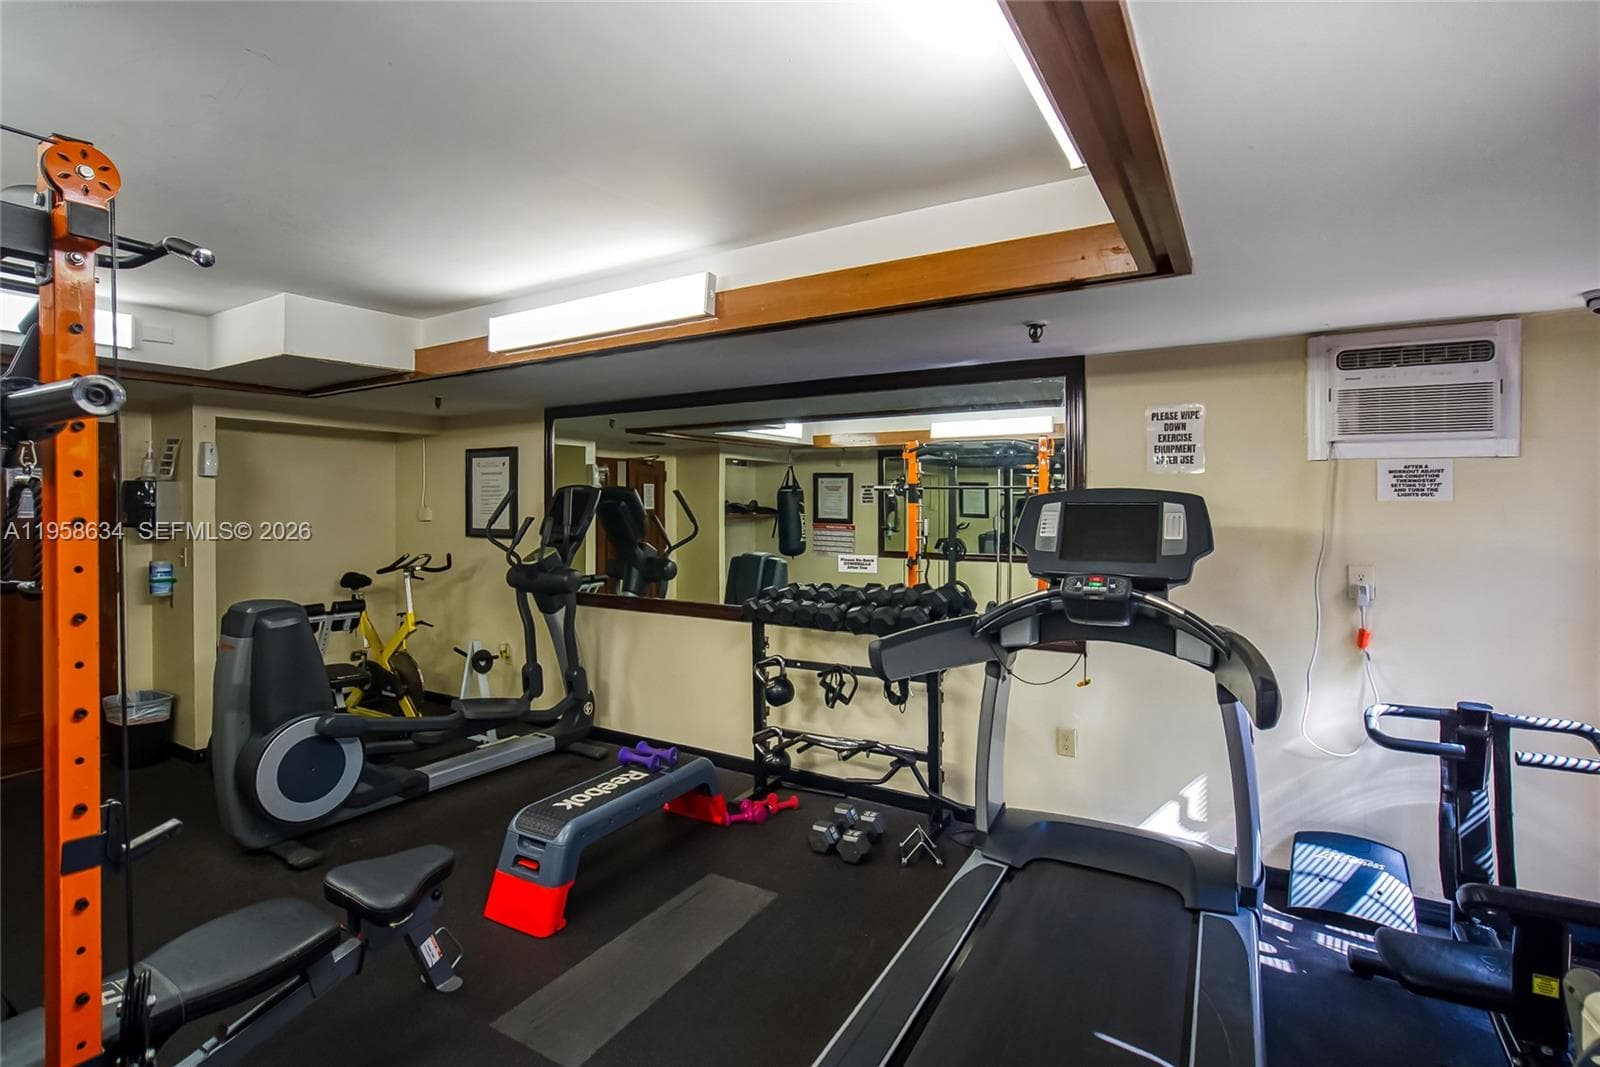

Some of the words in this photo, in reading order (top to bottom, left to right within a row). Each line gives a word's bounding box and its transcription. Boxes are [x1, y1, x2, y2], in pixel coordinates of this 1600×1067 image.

[1151, 411, 1179, 421] PLEASE
[1180, 410, 1200, 420] WIPE
[1163, 422, 1187, 432] DOWN
[1157, 433, 1193, 443] EXERCISE
[552, 769, 649, 810] Reebok
